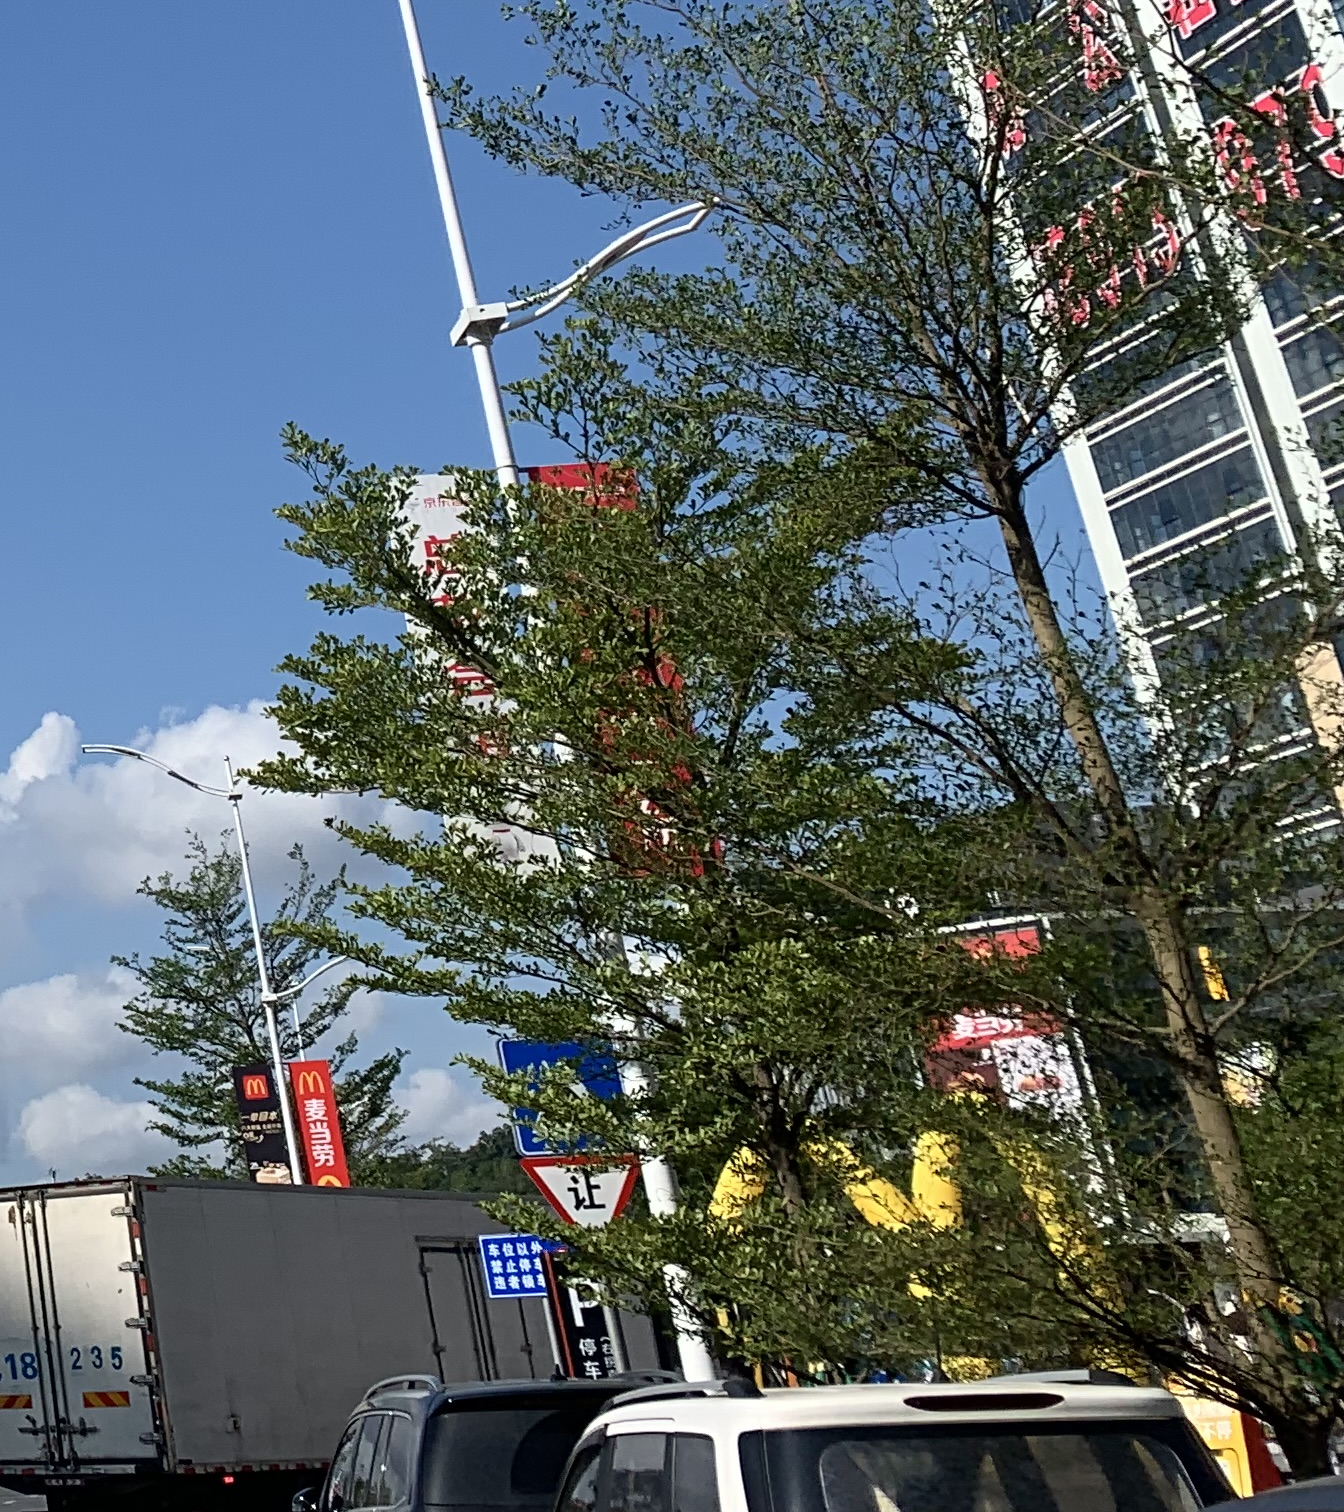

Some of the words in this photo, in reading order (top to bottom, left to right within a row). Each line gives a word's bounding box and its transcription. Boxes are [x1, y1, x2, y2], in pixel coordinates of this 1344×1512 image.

[303, 1098, 335, 1168] 麦当劳
[568, 1168, 606, 1210] 让
[488, 1241, 543, 1257] 车位以外
[579, 1338, 601, 1380] 停车
